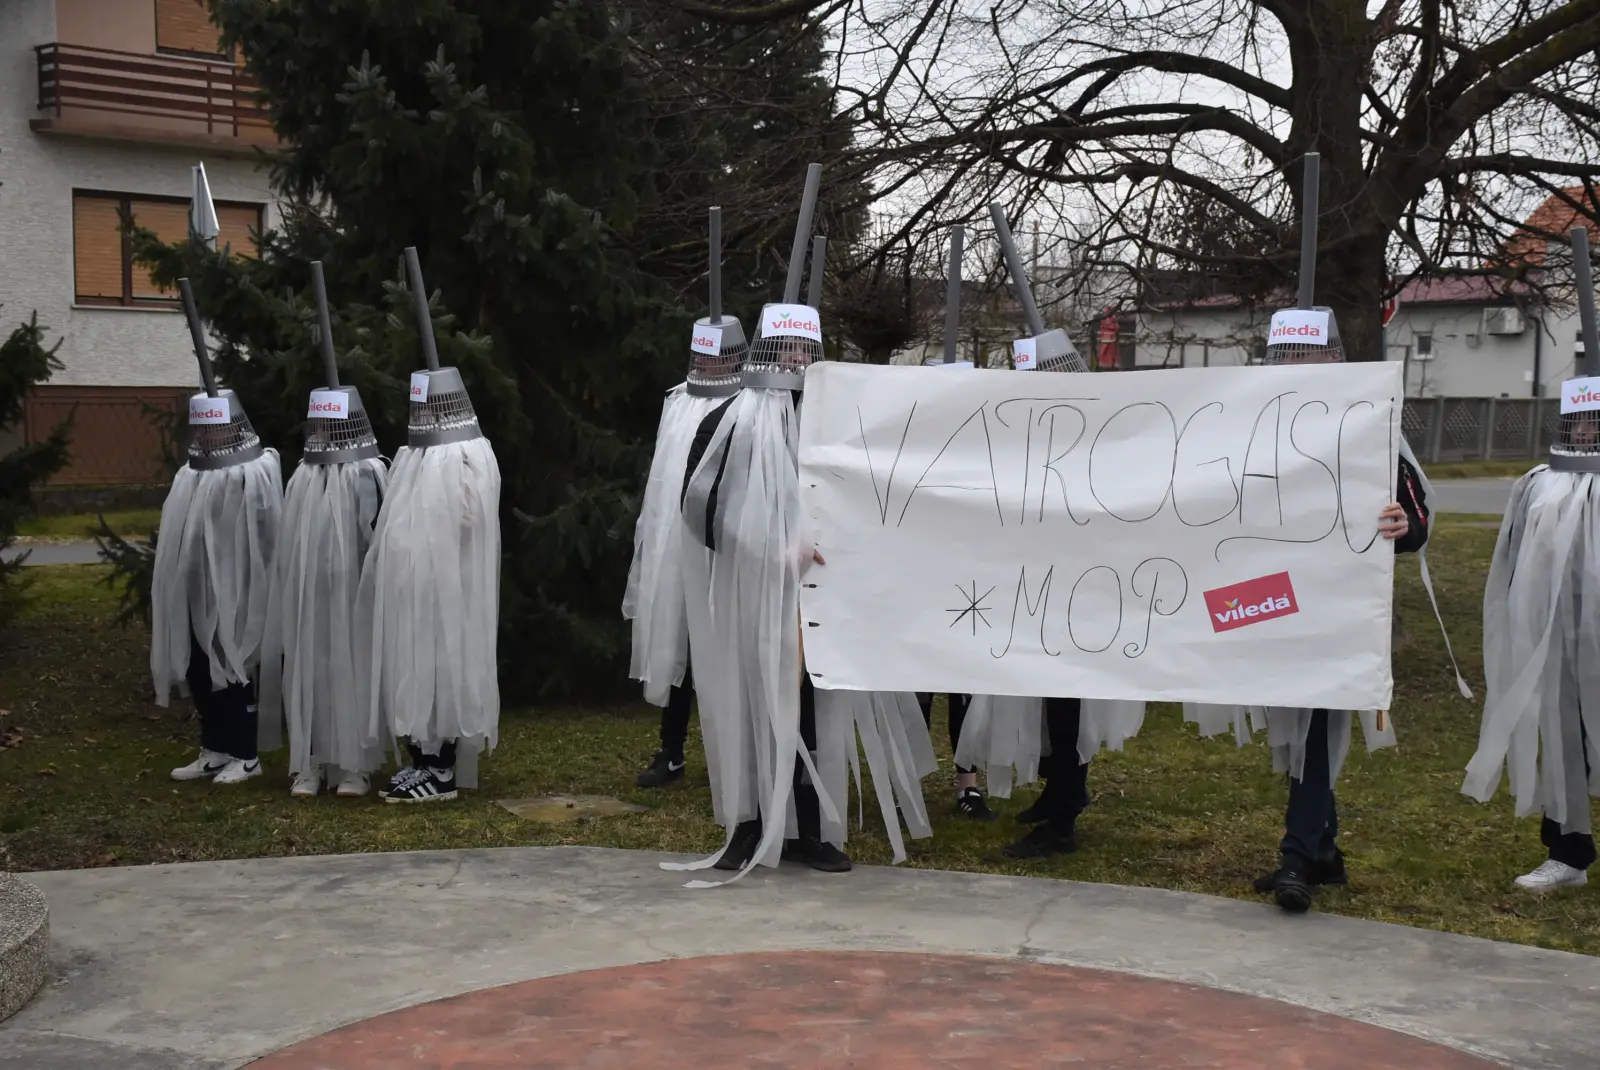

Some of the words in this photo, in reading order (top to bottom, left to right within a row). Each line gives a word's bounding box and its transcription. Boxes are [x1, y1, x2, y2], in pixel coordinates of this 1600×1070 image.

[772, 318, 818, 333] vileda
[1272, 324, 1321, 337] vileda
[1570, 390, 1600, 404] vile
[856, 391, 1394, 561] VATROGASCI
[1213, 595, 1292, 624] vileda
